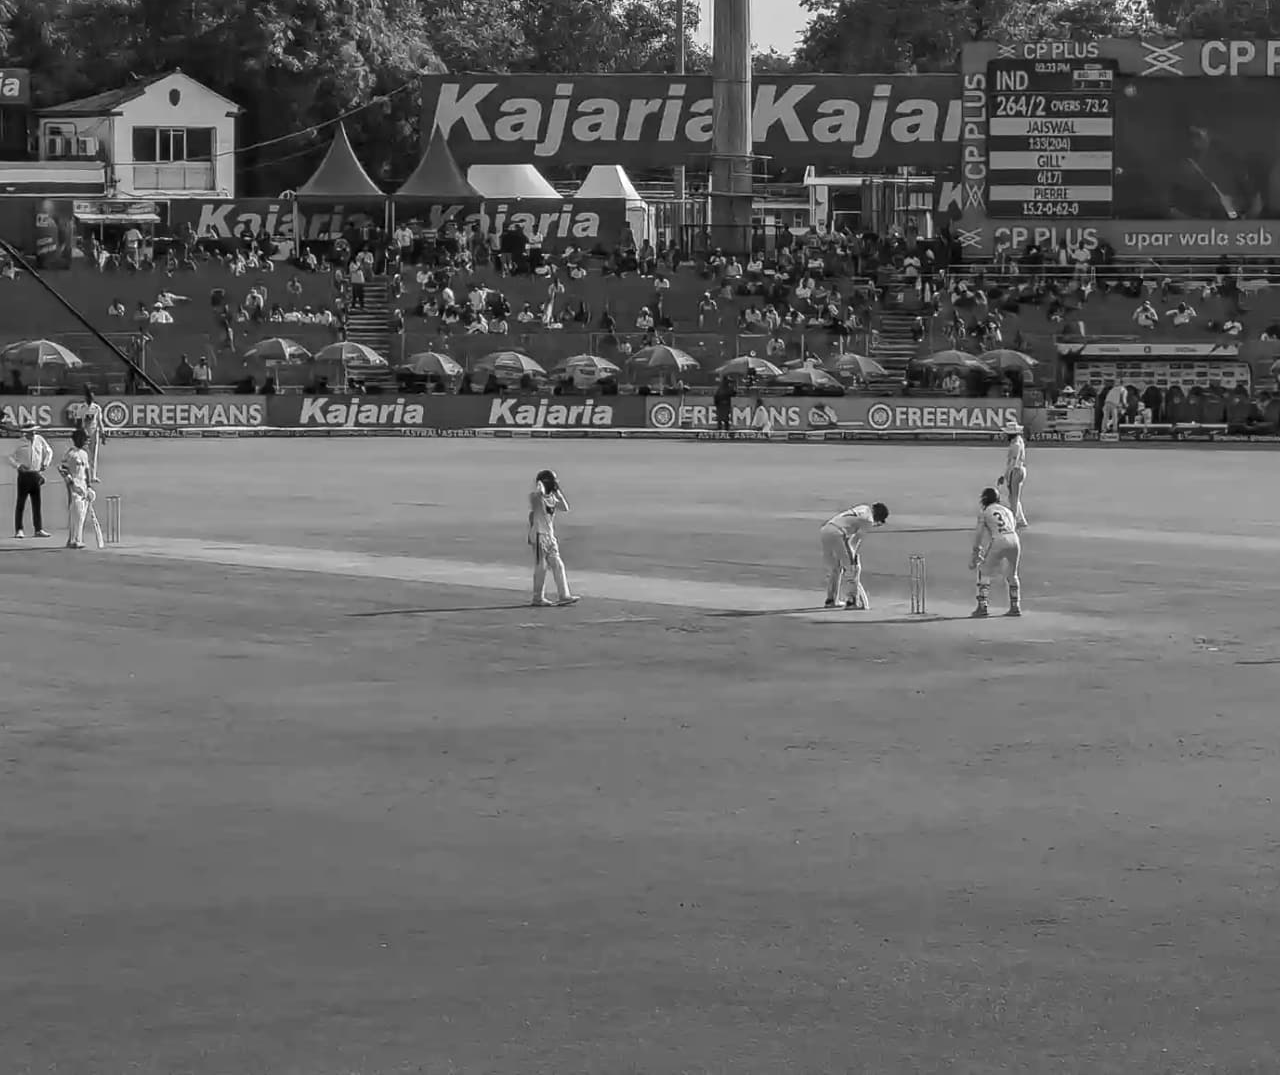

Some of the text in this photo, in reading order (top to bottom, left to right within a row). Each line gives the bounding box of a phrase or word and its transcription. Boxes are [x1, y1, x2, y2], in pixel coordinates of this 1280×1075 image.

[1024, 42, 1099, 59] CP PLUS
[1201, 40, 1255, 76] CP
[996, 70, 1028, 90] IND
[997, 96, 1046, 116] 264/2
[1051, 100, 1080, 112] OVERS
[965, 74, 986, 180] CP PLUS
[1027, 121, 1077, 134] JAISWAL
[995, 228, 1028, 249] CP
[1124, 232, 1173, 251] upar
[1180, 228, 1229, 245] wala
[1235, 228, 1271, 245] sab
[132, 404, 262, 425] FREEMANS
[300, 398, 613, 427] Kajaria Kajaria
